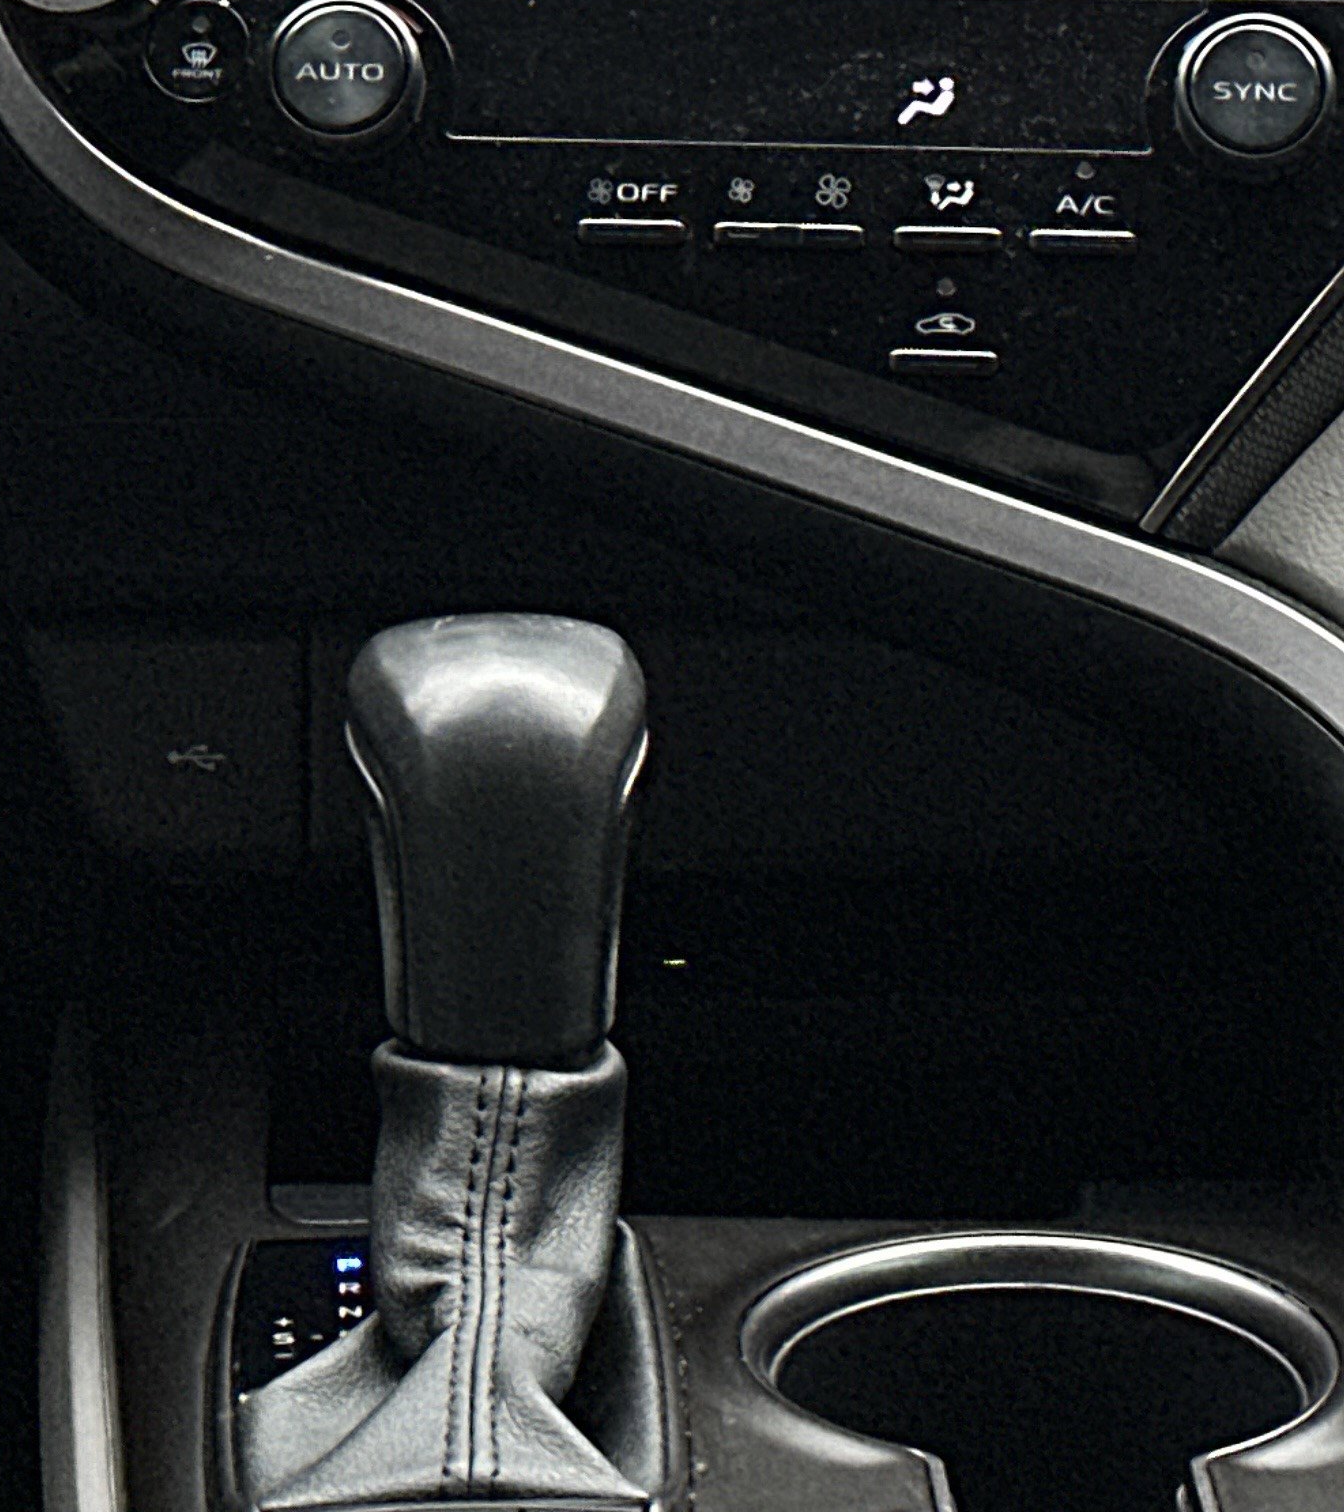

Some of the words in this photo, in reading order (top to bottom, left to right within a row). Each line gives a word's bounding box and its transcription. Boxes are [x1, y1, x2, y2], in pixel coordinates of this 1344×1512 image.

[296, 62, 385, 82] AUTO
[1213, 81, 1298, 103] SYNC
[616, 182, 678, 203] OFF
[1056, 194, 1115, 215] A/C
